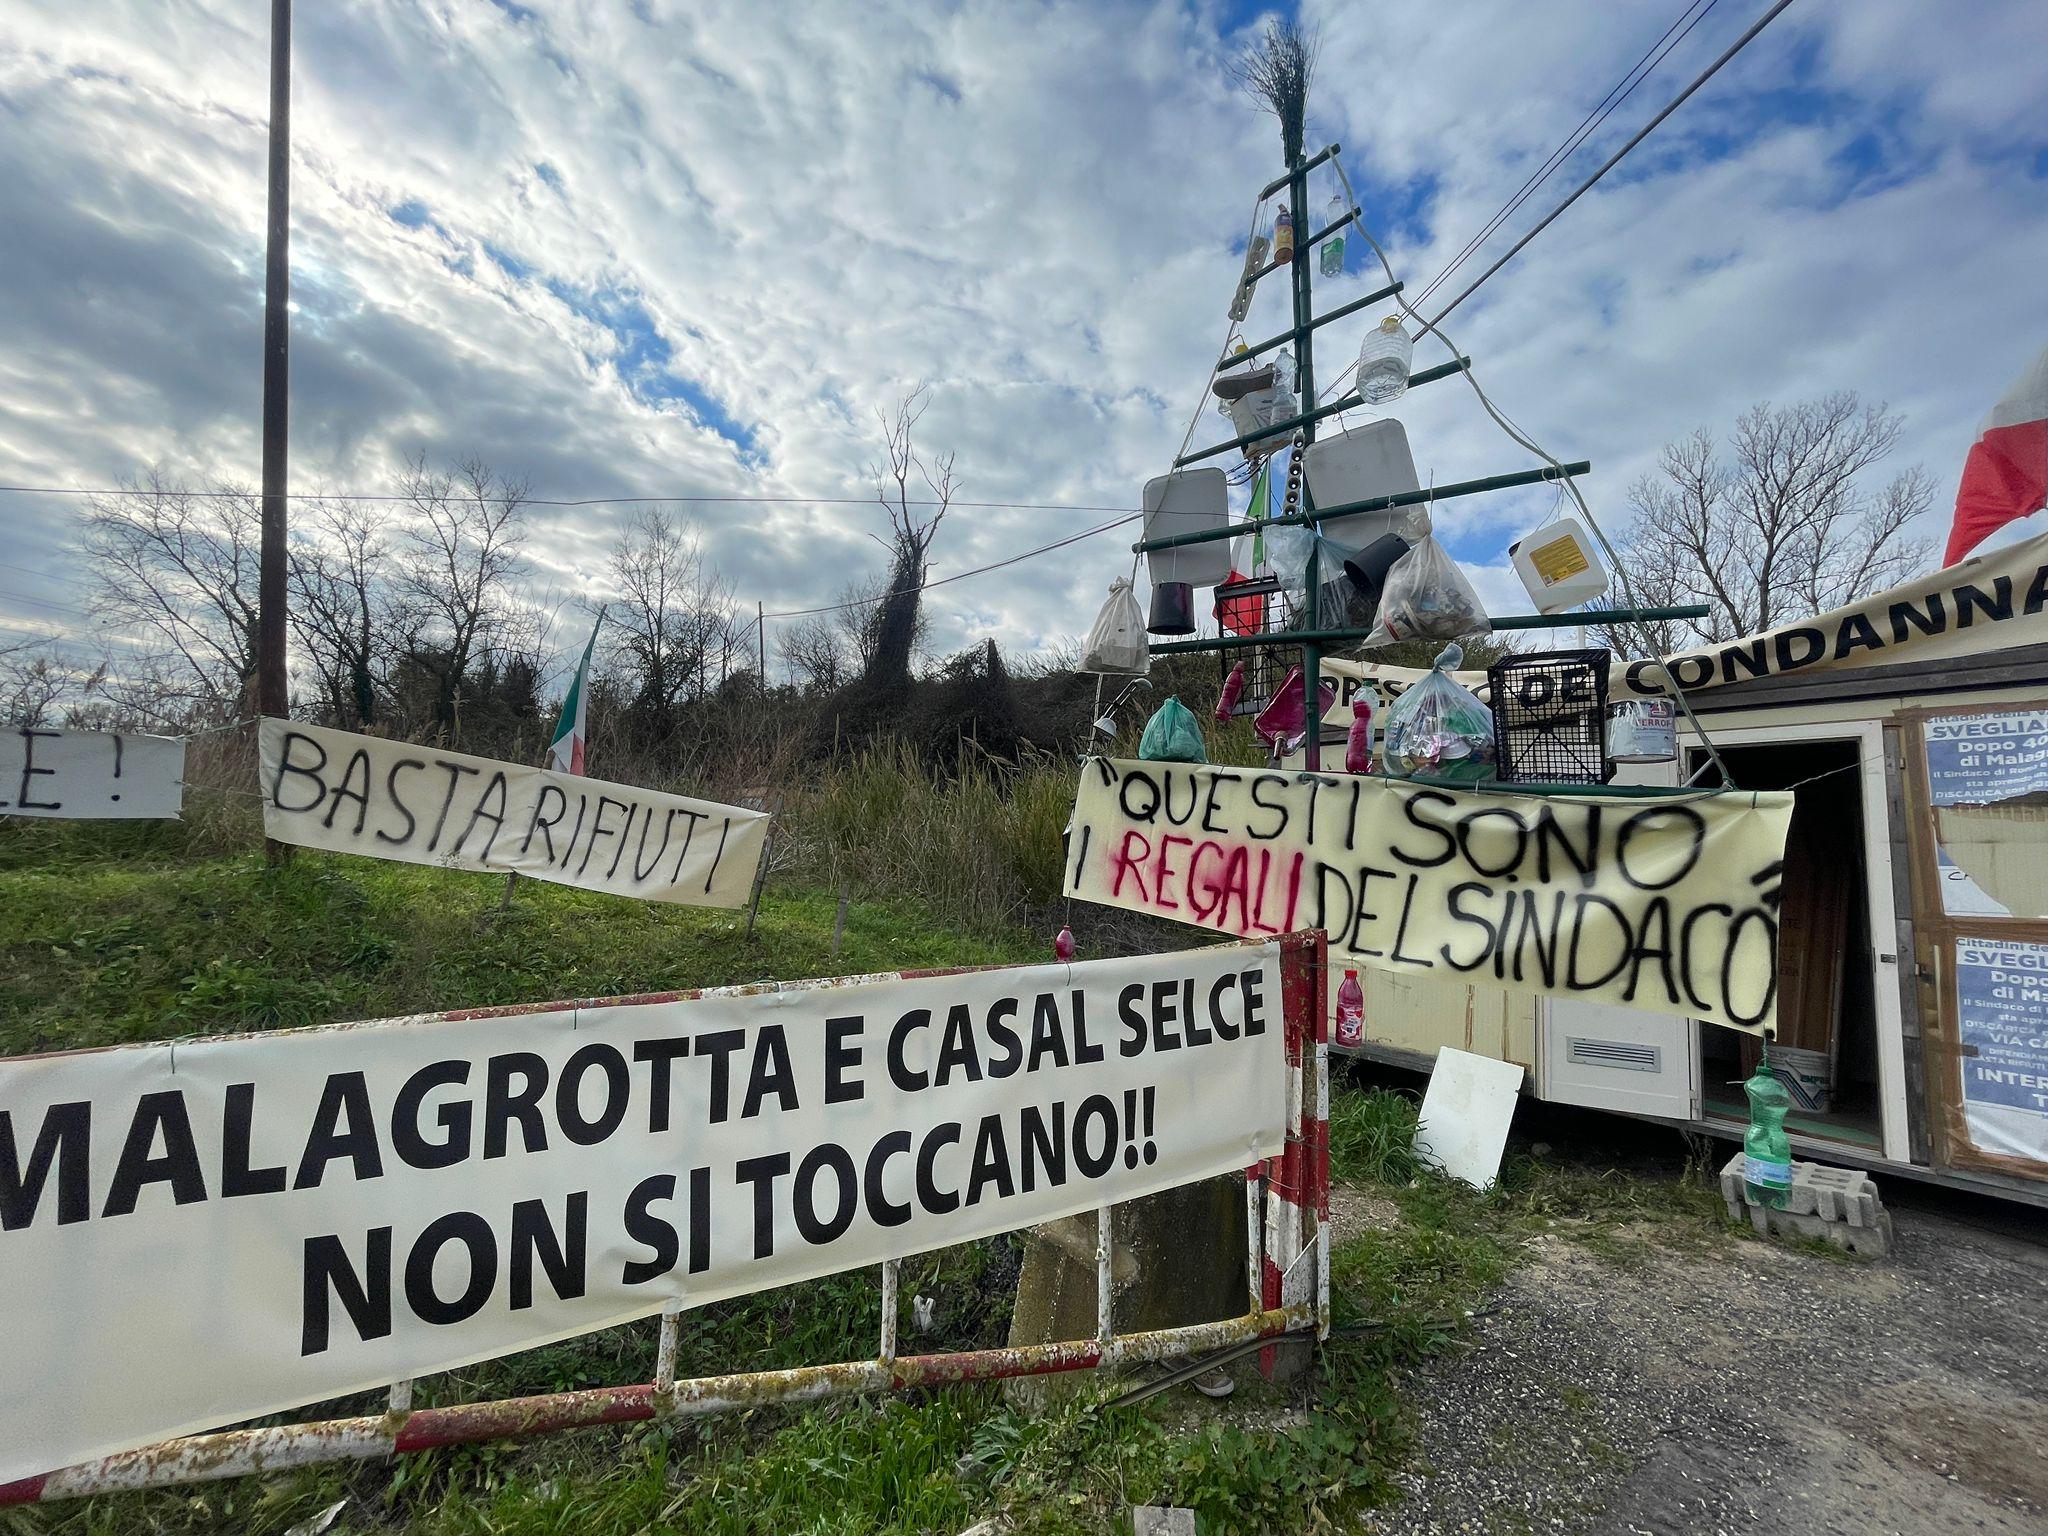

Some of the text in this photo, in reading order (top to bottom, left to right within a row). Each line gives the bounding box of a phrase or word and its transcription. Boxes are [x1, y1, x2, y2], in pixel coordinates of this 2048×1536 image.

[1932, 719, 2048, 738] SVEGLIA
[1958, 741, 2016, 753] Dopo
[1960, 749, 2048, 767] di Malag
[1943, 768, 1991, 778] Sindaco
[1994, 768, 2005, 776] di
[273, 732, 731, 894] BASTA RIFIUTI
[1389, 790, 1706, 890] SONO
[1073, 825, 1091, 889] I
[1113, 830, 1304, 934] REGALI
[1310, 862, 1433, 967] DEL
[1956, 937, 2025, 951] Cittadini
[1992, 986, 2014, 999] di
[1974, 999, 2025, 1011] Sindaco
[1989, 1032, 2024, 1047] VIA
[0, 969, 1266, 1231] MALAGROTTA E CASAL SELCE
[301, 1085, 1158, 1357] NON SI TOCCANO!!
